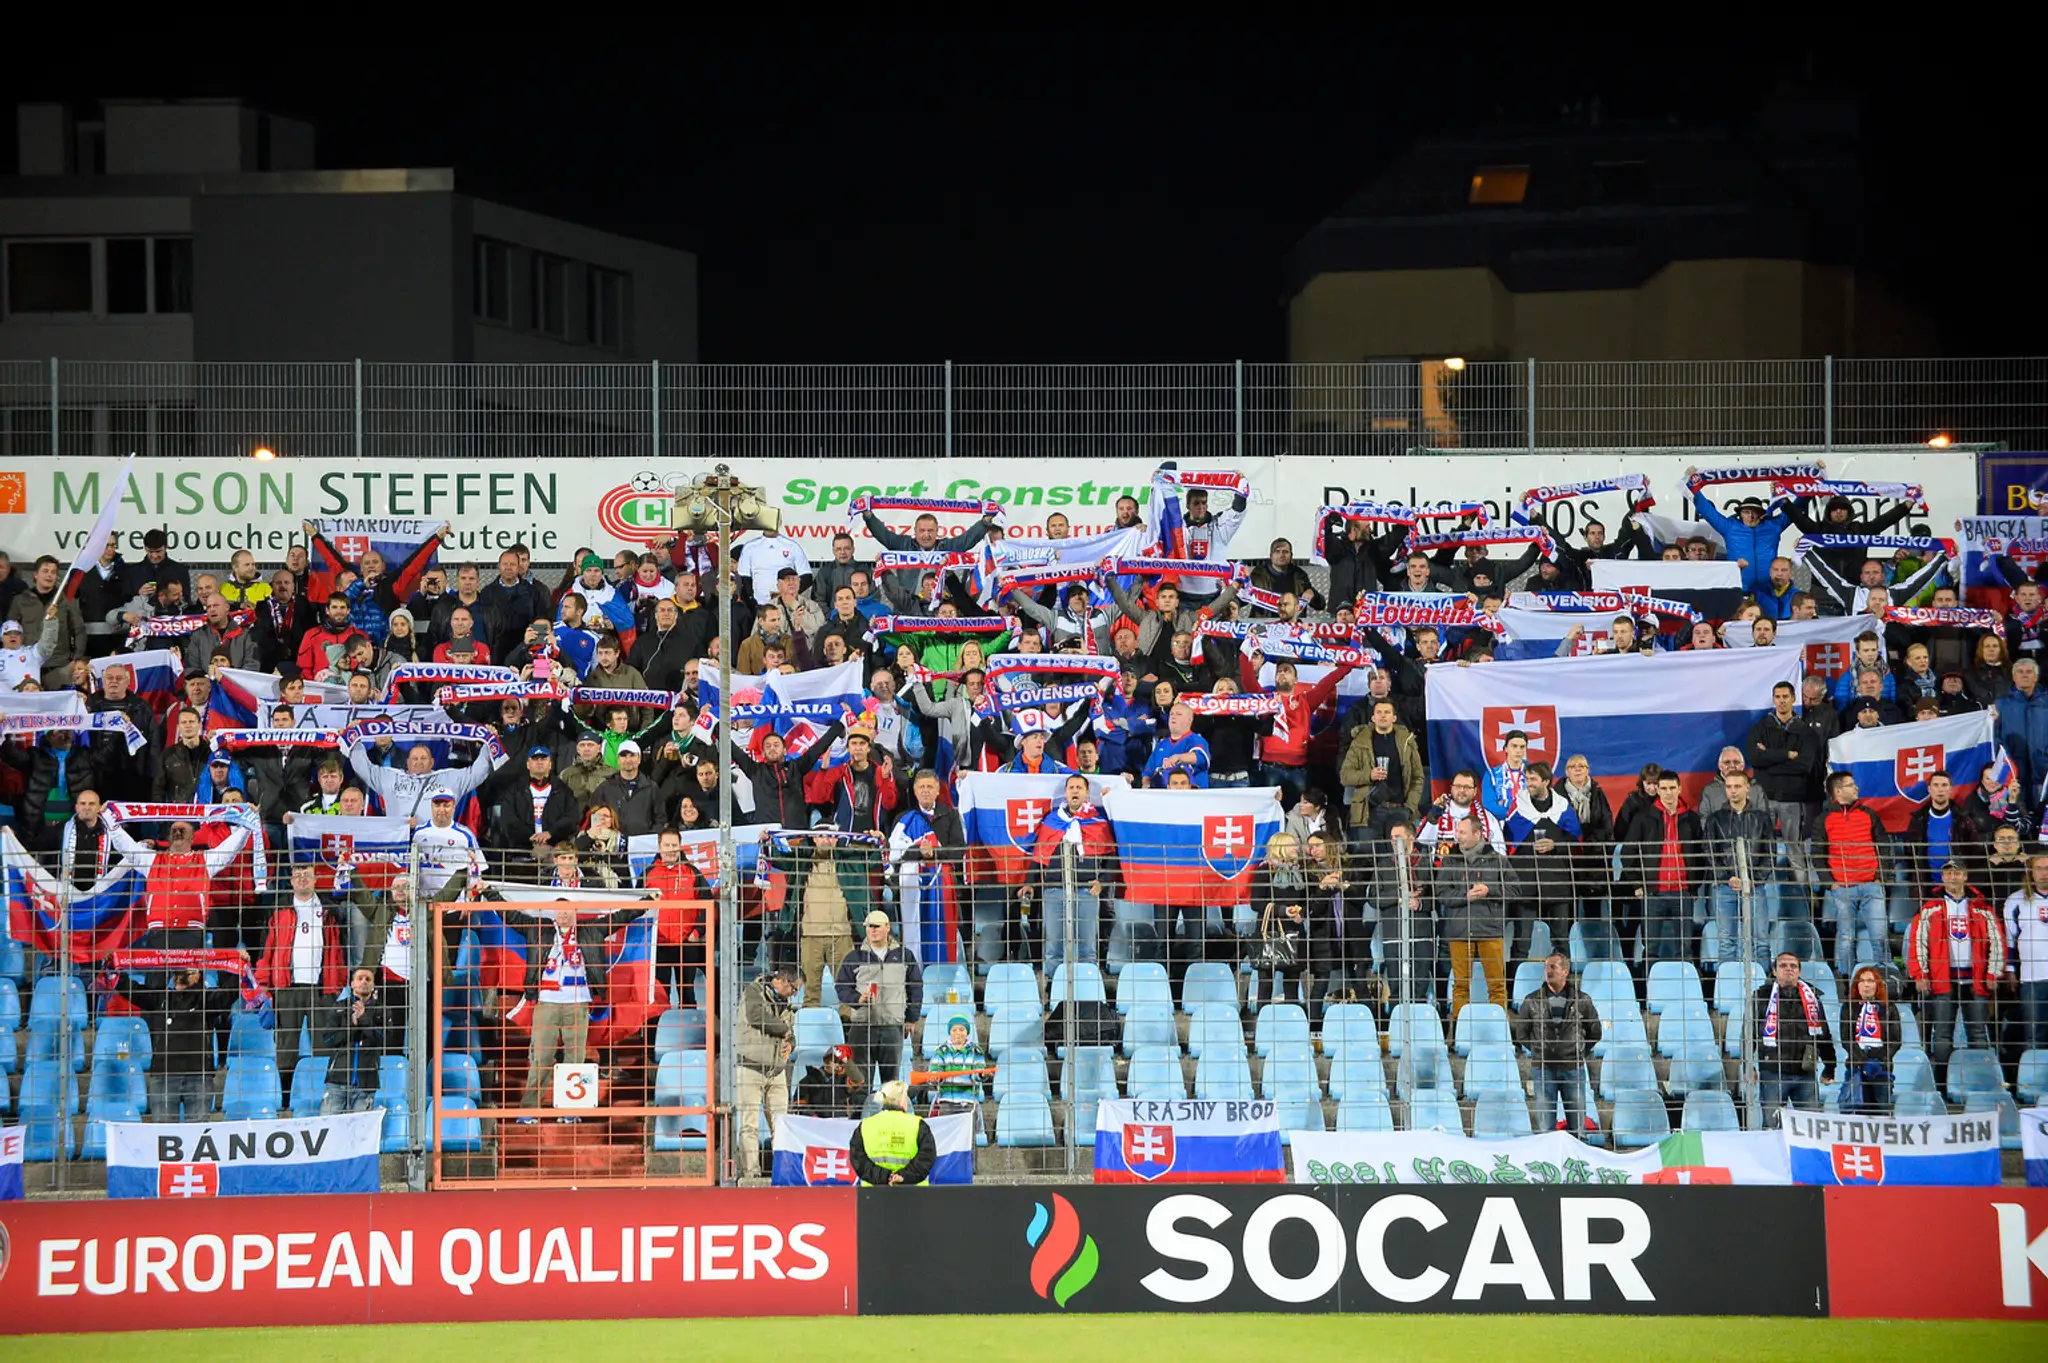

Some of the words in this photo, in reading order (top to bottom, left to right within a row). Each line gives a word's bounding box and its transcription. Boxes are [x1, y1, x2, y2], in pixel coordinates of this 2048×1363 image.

[1704, 464, 1821, 481] SLOVENSKO
[54, 471, 293, 515] MAISON
[320, 472, 557, 515] STEFFEN
[783, 478, 929, 511] Sport
[944, 478, 1183, 506] Constru
[54, 530, 143, 550] vore
[162, 523, 310, 550] boucheri
[883, 552, 945, 566] SLOVA
[1034, 566, 1098, 581] SLOVENS
[1898, 606, 1994, 624] SLOVENSKO
[1264, 639, 1359, 663] SLOVENSKO
[402, 666, 515, 682] SLOVENSKO
[456, 681, 553, 698] SLOVAKIA
[581, 690, 665, 704] SLOVAKIA
[1001, 685, 1097, 706] SLOVENSKO
[1189, 697, 1280, 711] SLOVENSKO
[1, 715, 83, 730] VENSKO
[367, 721, 488, 737] SLOVENSKO
[246, 731, 317, 744] SLOVAKIA
[125, 805, 205, 816] SLOVAKIA
[302, 921, 308, 934] 8
[565, 1072, 588, 1100] 3
[1790, 1116, 1932, 1145] LIPTOVSKÝ
[1943, 1119, 1992, 1144] JÁN
[158, 1127, 330, 1162] BÁNOV
[1139, 1193, 1657, 1304] SOCAR
[38, 1230, 414, 1297] EUROPEAN
[439, 1222, 830, 1296] QUALIFIERS
